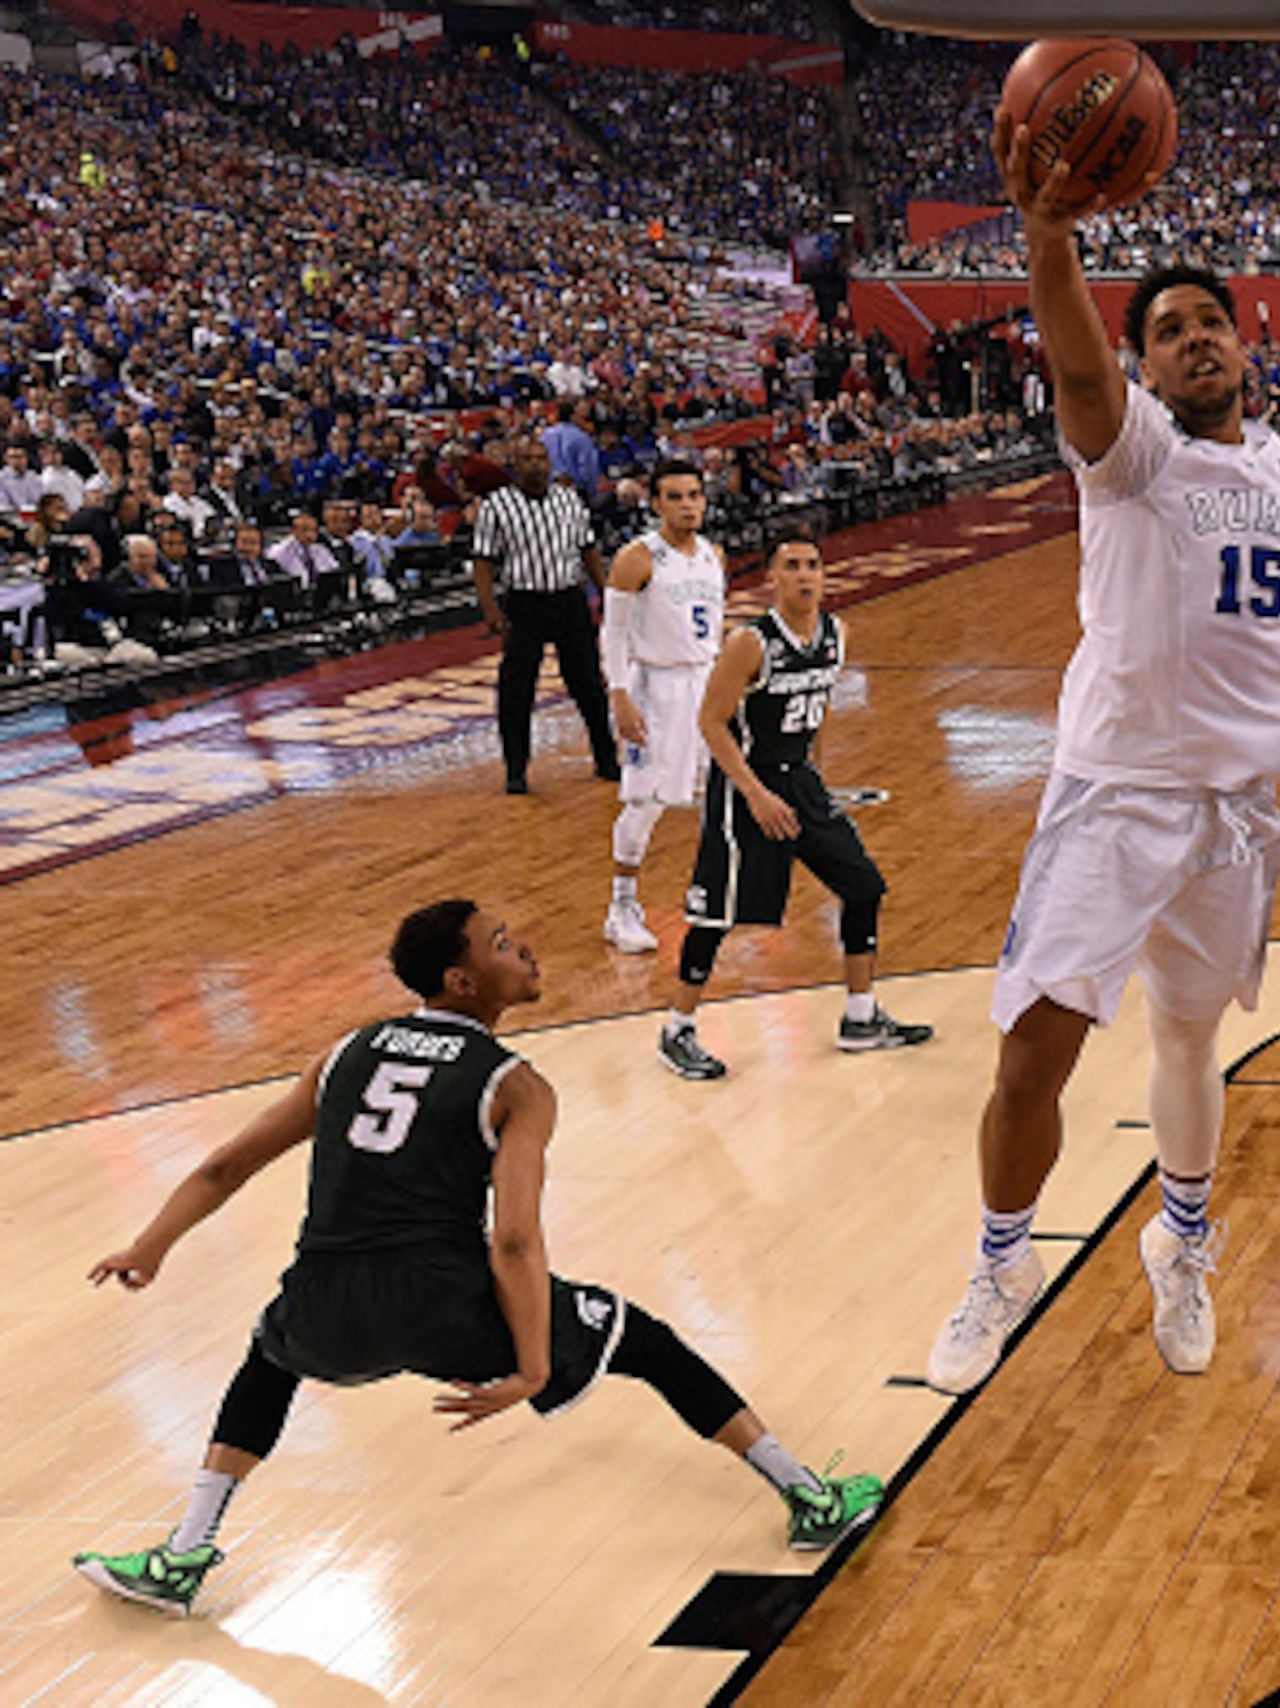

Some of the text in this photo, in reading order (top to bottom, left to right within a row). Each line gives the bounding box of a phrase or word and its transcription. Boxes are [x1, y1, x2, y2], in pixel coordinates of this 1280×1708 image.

[692, 606, 710, 639] 5
[780, 693, 828, 734] 20
[348, 1062, 434, 1153] 5
